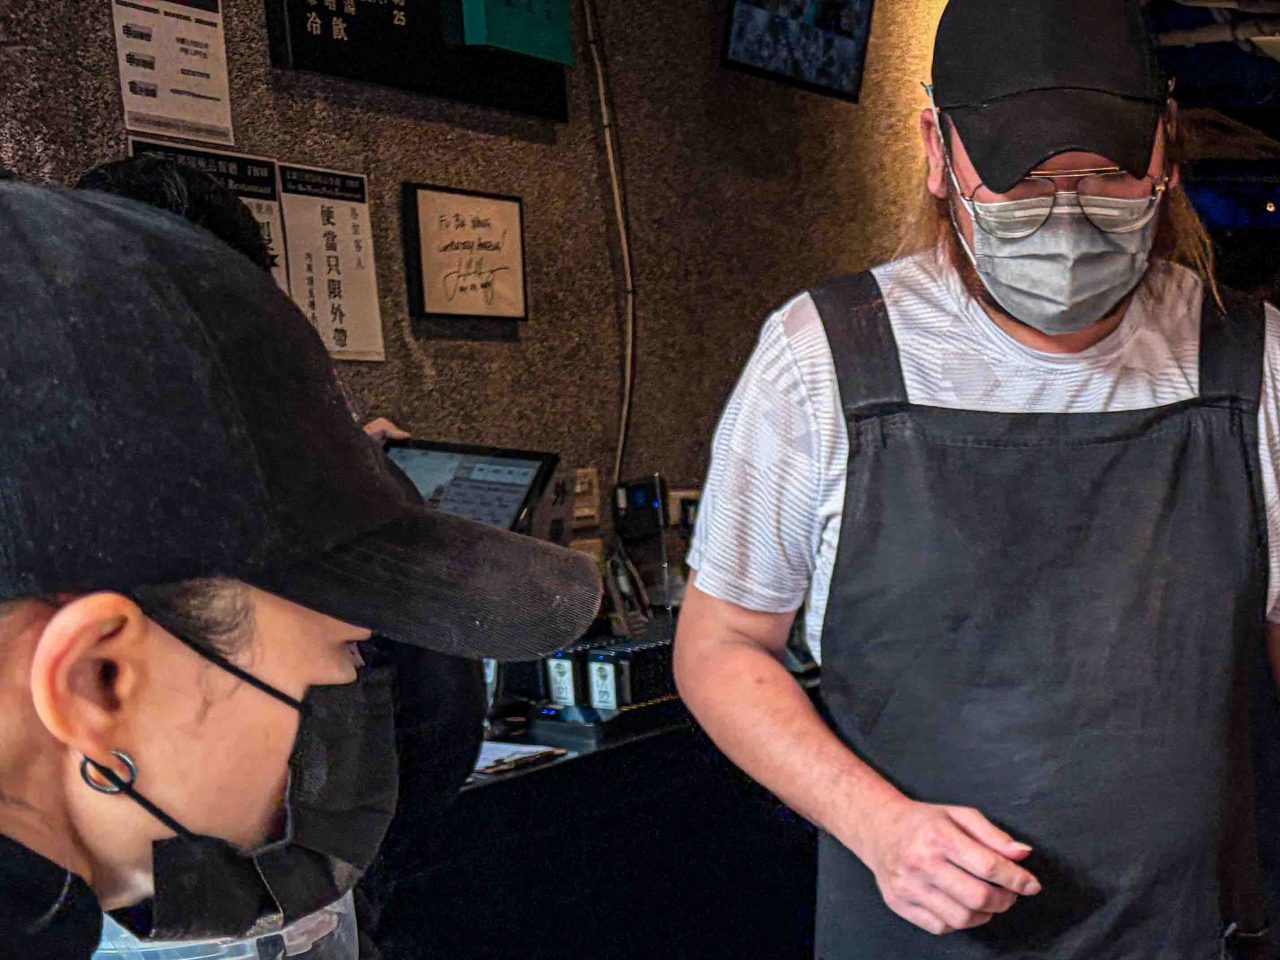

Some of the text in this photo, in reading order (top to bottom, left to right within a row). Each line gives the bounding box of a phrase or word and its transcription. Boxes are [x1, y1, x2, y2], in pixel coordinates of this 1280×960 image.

[306, 11, 349, 41] 冷飲
[320, 204, 348, 348] 便當只限外帶
